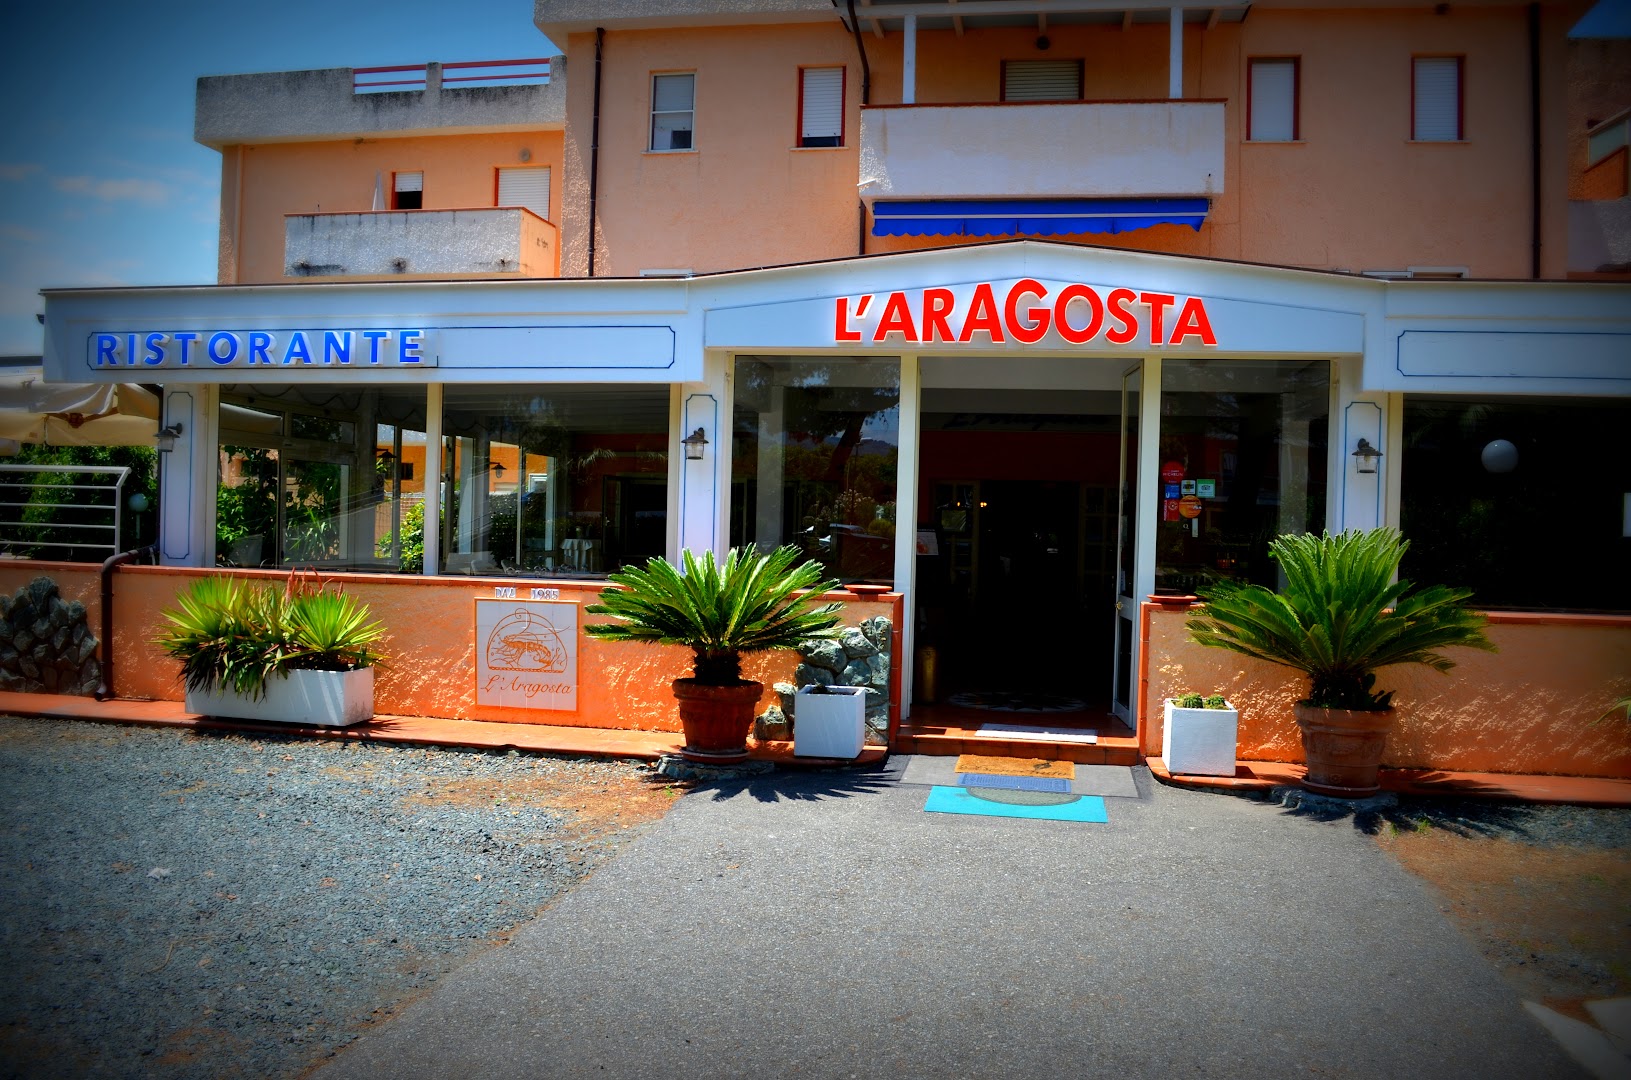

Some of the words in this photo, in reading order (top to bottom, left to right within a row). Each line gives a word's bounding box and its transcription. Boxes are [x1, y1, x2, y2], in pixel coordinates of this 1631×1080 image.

[834, 278, 1217, 346] L'ARAGOSTA
[96, 330, 424, 366] RISTORANTE
[532, 589, 559, 600] 1985
[480, 674, 572, 698] L'Aragosta
